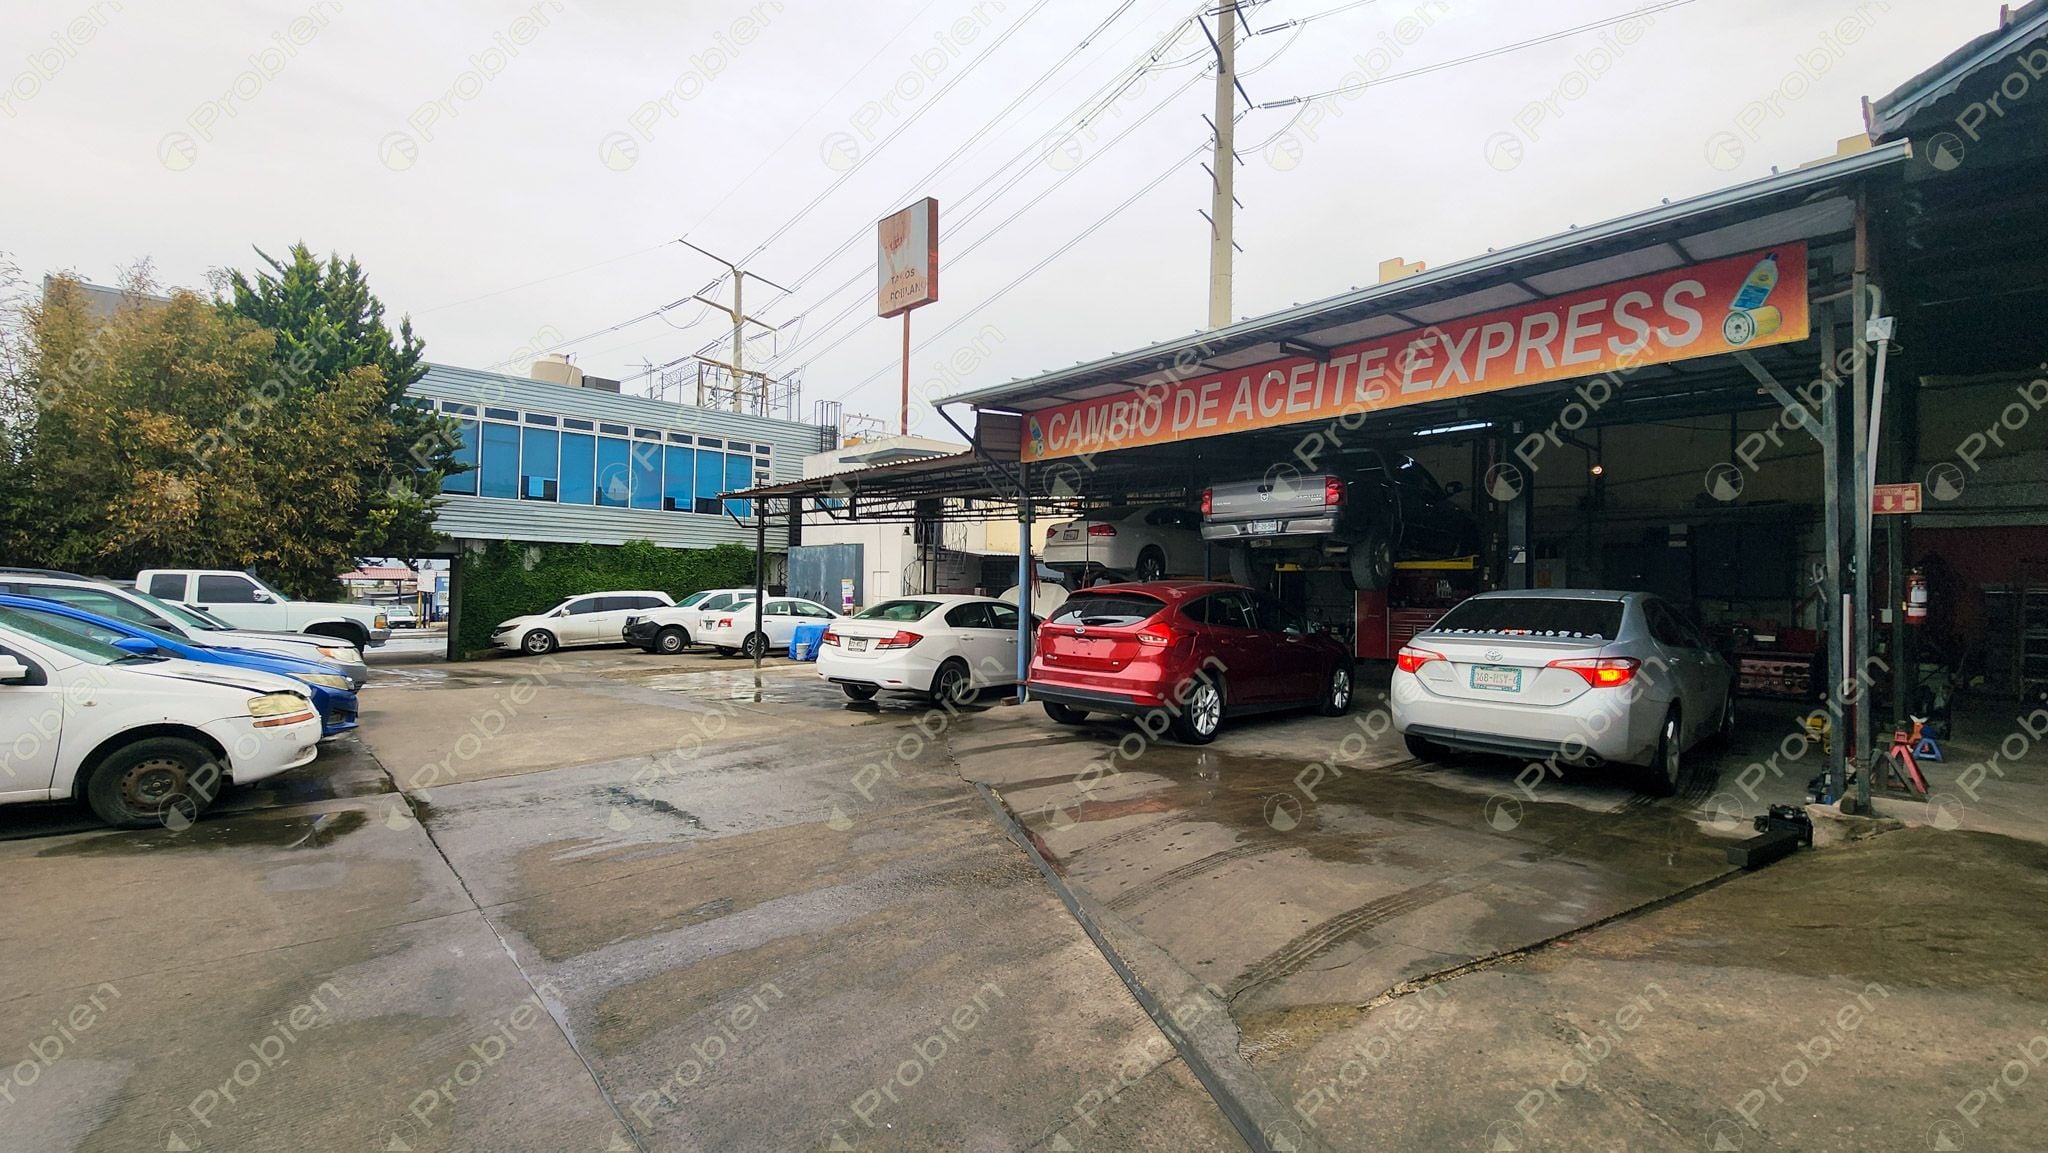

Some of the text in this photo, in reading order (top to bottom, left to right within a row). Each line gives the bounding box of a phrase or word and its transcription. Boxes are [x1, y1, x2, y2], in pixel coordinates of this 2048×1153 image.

[1048, 280, 1706, 451] CAMBIO DE ACEITE EXPRESS
